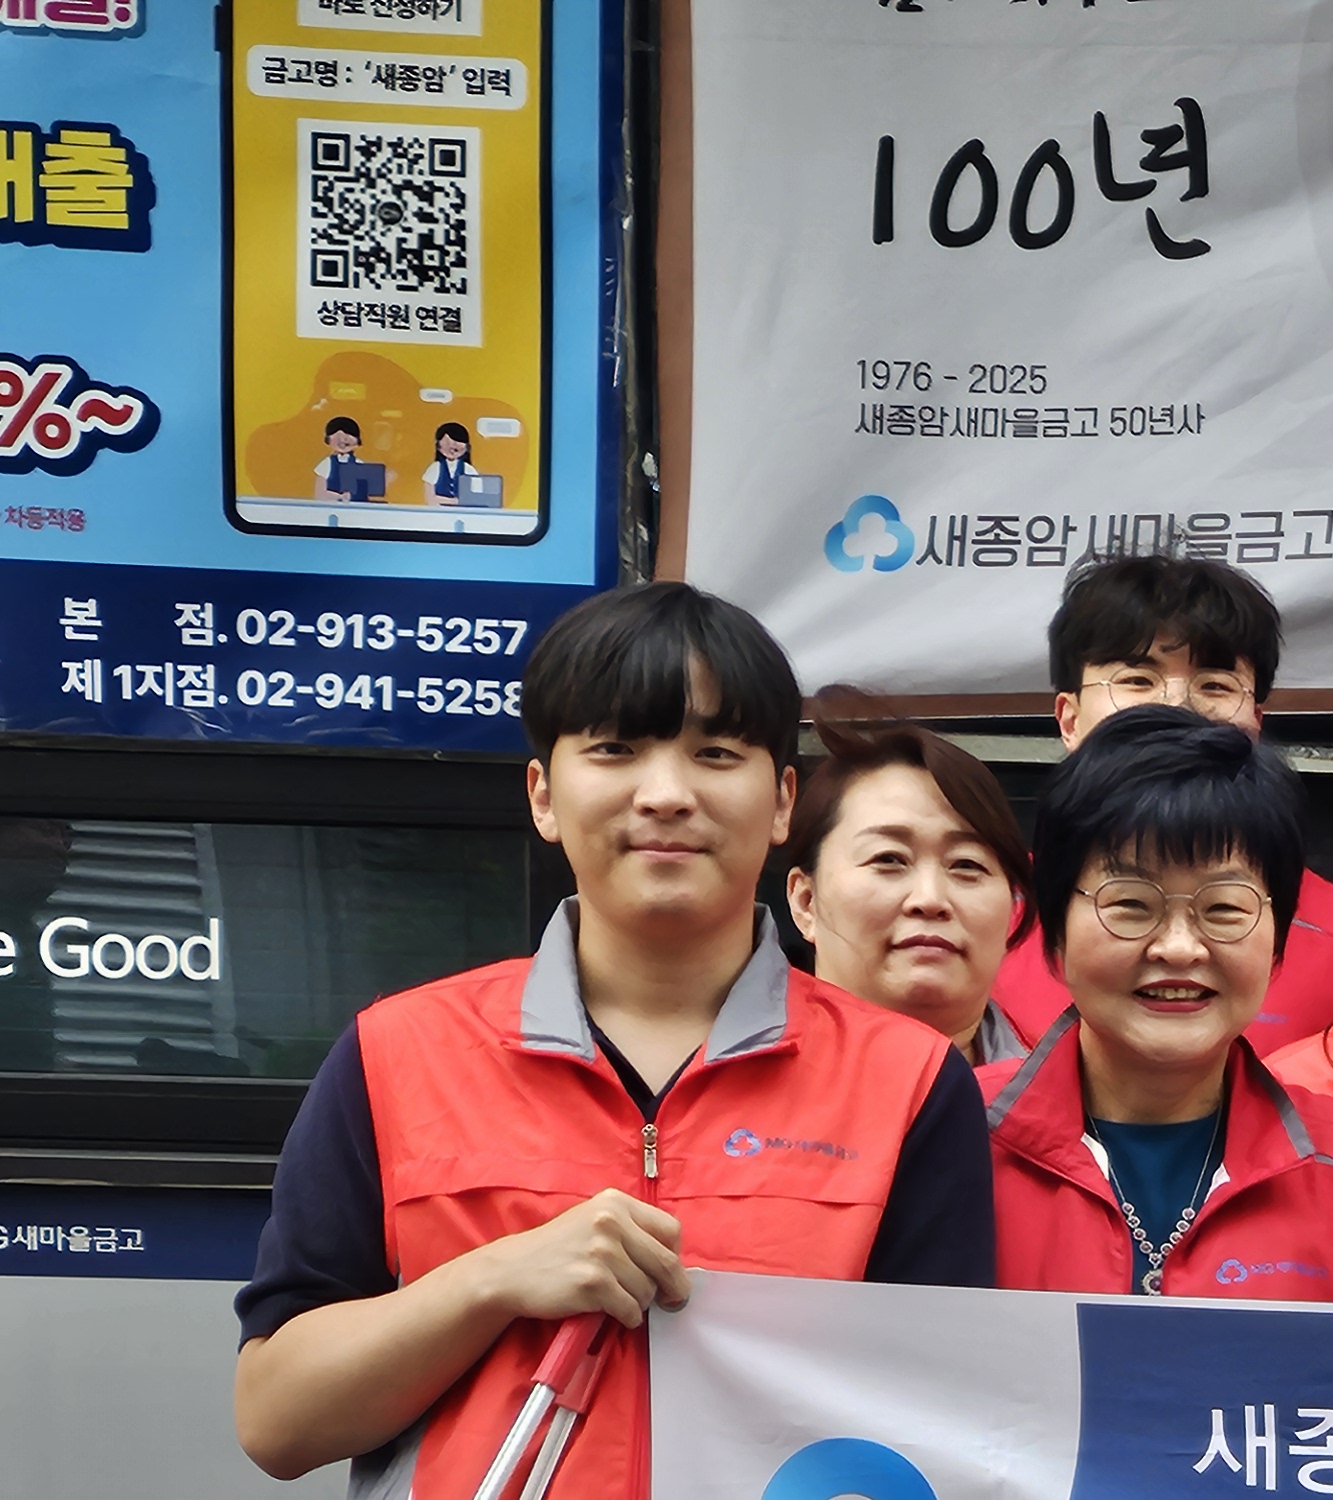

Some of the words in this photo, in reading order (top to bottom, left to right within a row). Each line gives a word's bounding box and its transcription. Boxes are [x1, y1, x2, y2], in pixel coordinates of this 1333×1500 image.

[262, 57, 338, 87] 금고명
[462, 67, 512, 97] 입력
[872, 97, 1212, 260] 100년
[316, 300, 412, 330] 상담직원
[415, 306, 463, 334] 연결
[855, 359, 932, 392] 1976
[968, 364, 1048, 394] 2025
[855, 402, 1100, 438] 새종암새마을금고
[1109, 404, 1206, 436] 50년사
[60, 598, 103, 641] 본
[236, 609, 528, 656] 02-913-5257
[39, 916, 221, 980] Good
